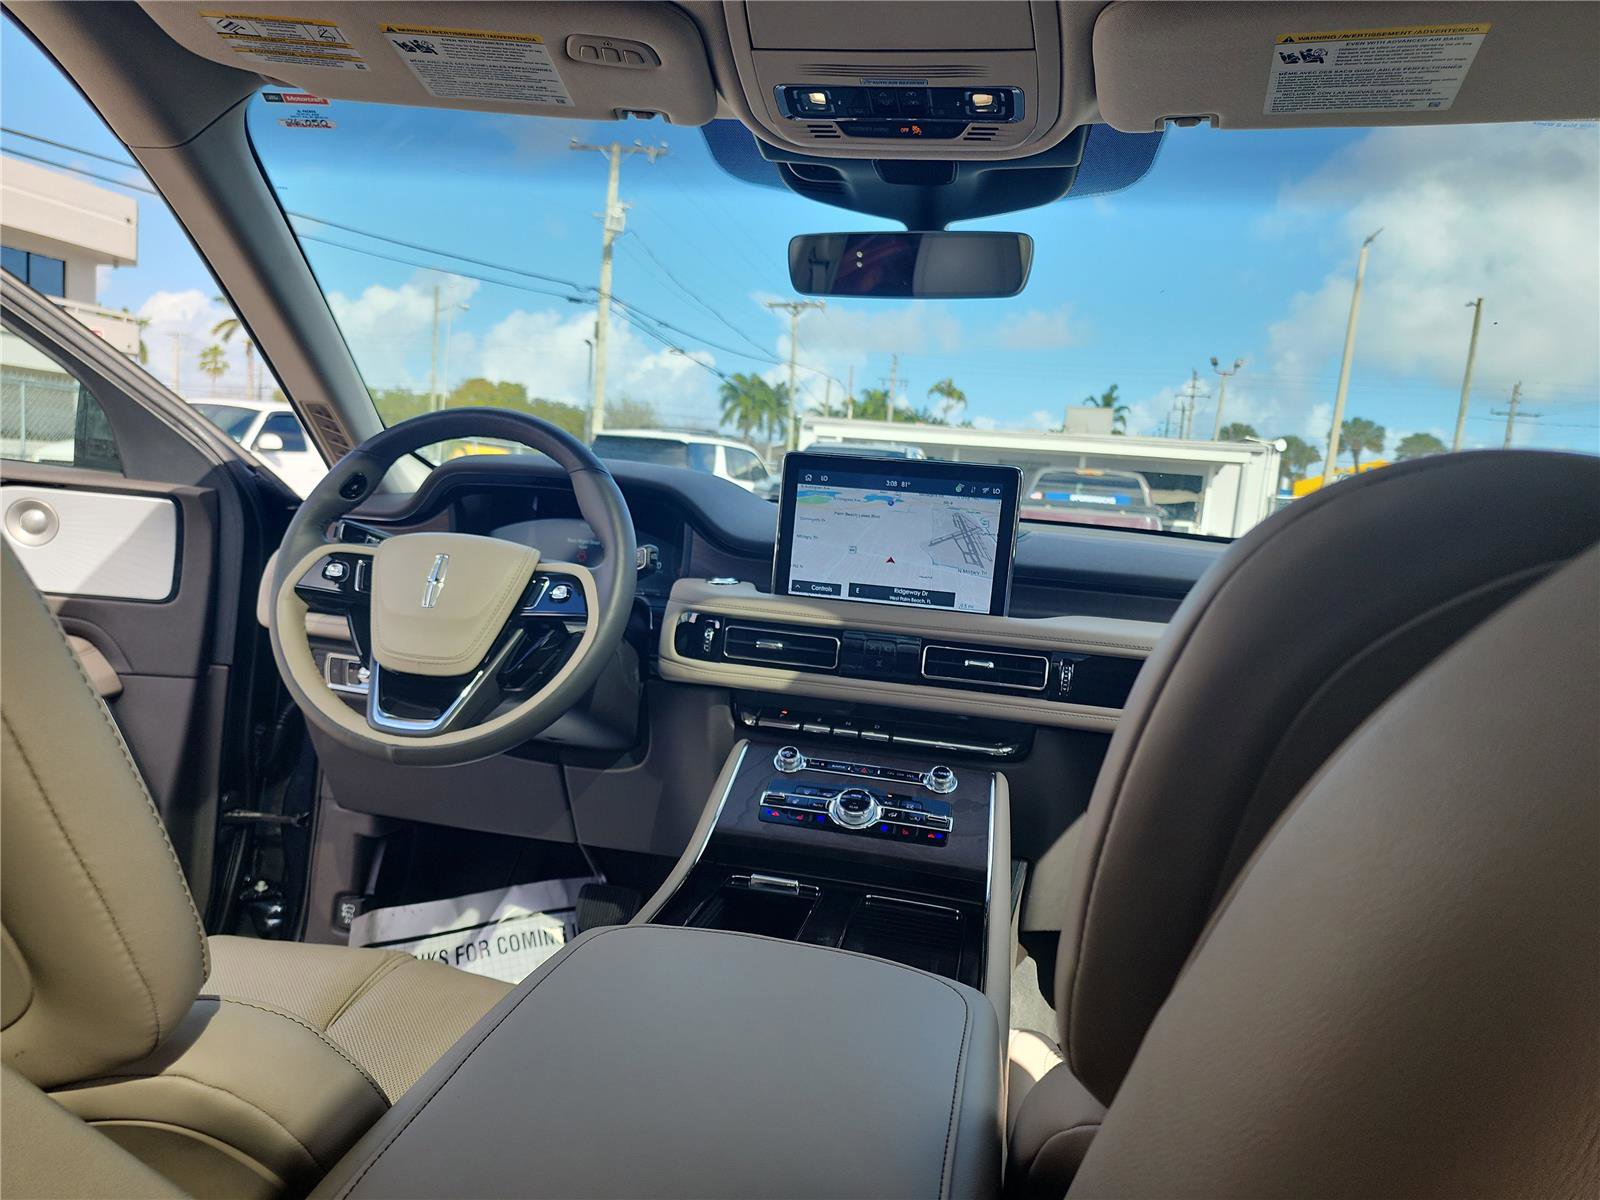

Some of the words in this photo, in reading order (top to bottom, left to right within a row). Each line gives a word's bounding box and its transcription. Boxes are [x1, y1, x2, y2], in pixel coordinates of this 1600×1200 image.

[811, 584, 833, 593] Controls
[893, 587, 921, 597] Ridgeway
[455, 940, 491, 966] FOR
[497, 926, 568, 956] COMIN
